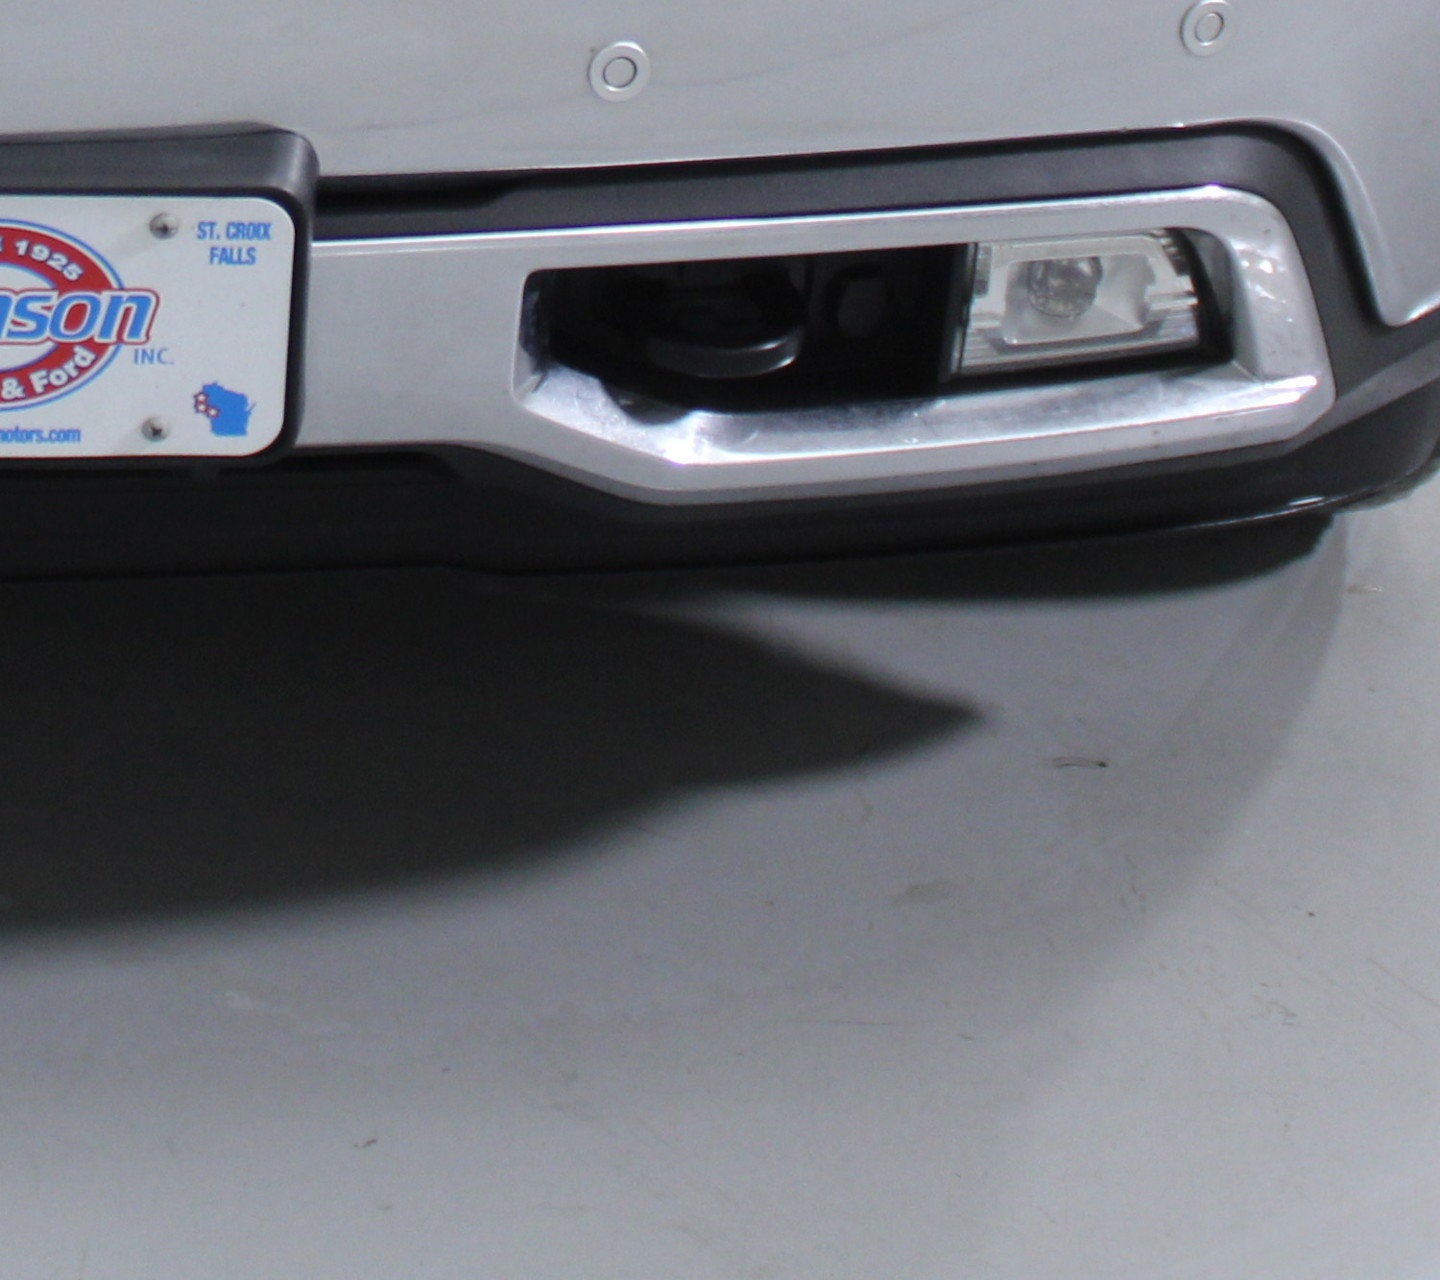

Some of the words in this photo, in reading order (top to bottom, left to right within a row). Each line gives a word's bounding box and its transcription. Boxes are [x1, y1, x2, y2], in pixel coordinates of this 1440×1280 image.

[196, 221, 221, 241] ST.
[225, 221, 272, 241] CROIX
[14, 239, 85, 282] 1925
[208, 246, 257, 266] FALLS
[133, 347, 174, 365] INC.
[1, 376, 26, 401] &
[28, 345, 97, 395] Ford
